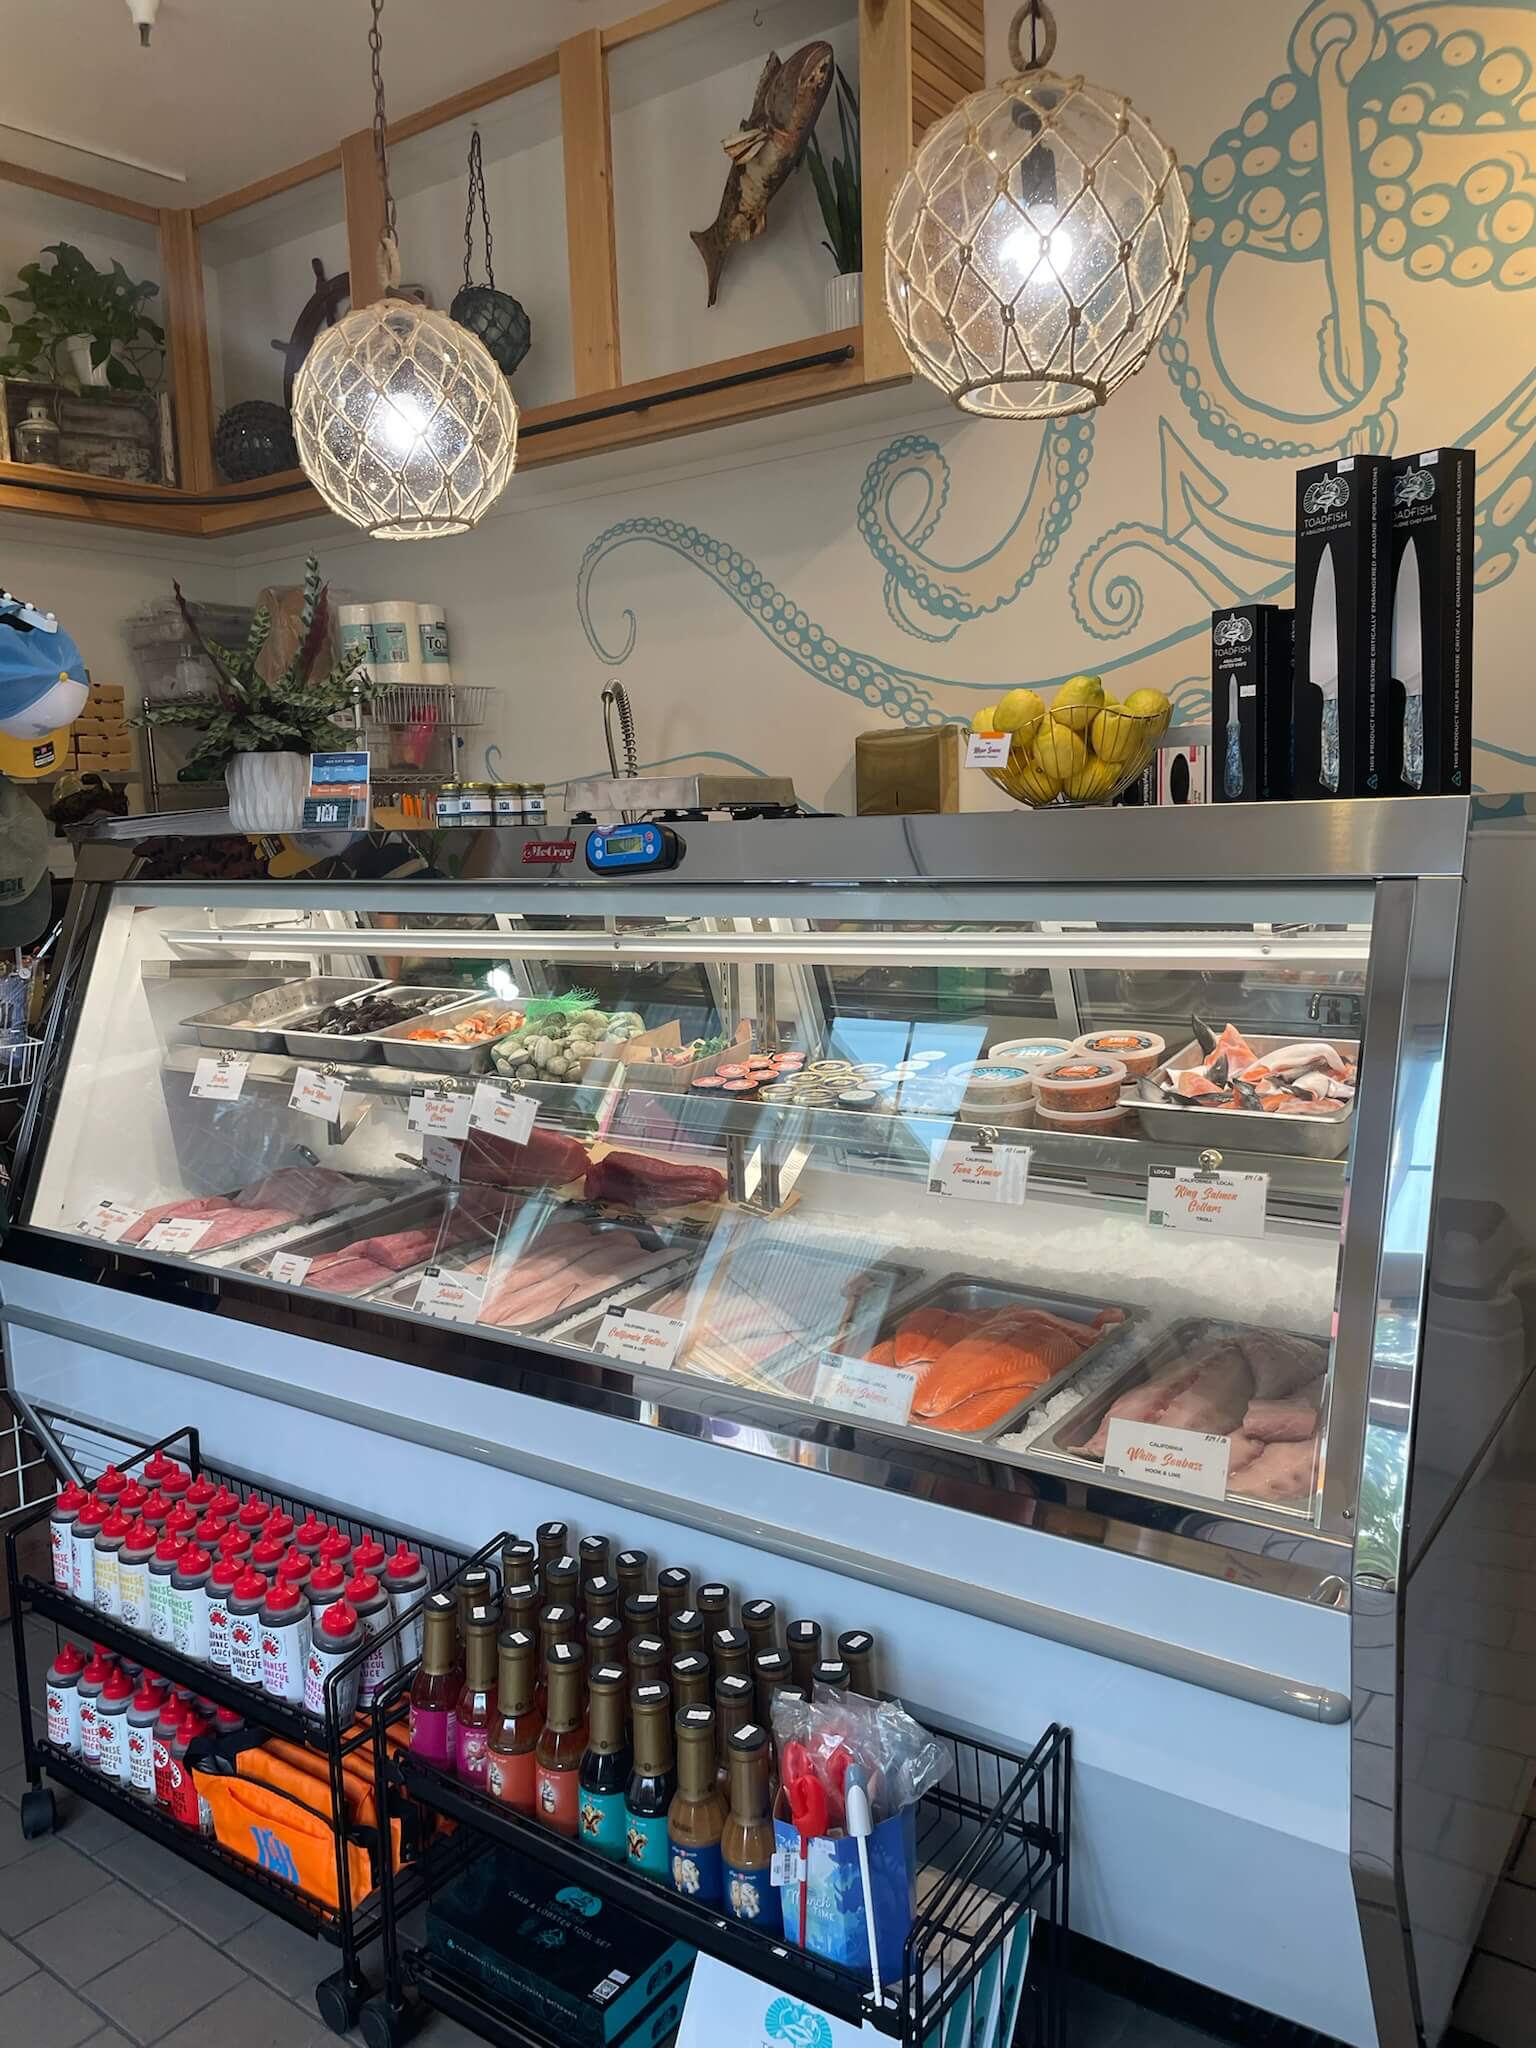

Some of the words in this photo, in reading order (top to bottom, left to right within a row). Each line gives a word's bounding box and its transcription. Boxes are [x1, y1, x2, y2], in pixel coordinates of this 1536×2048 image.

[1304, 510, 1348, 528] TOADFISH
[1394, 504, 1433, 520] ADFISH
[1214, 646, 1252, 658] TOADFISH
[1369, 658, 1377, 691] RESTORE
[1153, 1168, 1171, 1176] LOCAL
[1180, 1177, 1212, 1185] CALIFORNIA
[1174, 1184, 1198, 1199] King
[1201, 1187, 1238, 1200] Salmon
[1187, 1199, 1222, 1214] Collars
[1148, 1441, 1183, 1452] CALIFORNIA
[1127, 1446, 1158, 1462] White
[1160, 1453, 1204, 1472] Seabass
[1168, 1471, 1181, 1479] LINE
[508, 1890, 529, 1905] CRAB
[536, 1906, 572, 1928] LOBSTER
[573, 1926, 593, 1940] TOOL
[594, 1937, 612, 1949] SET
